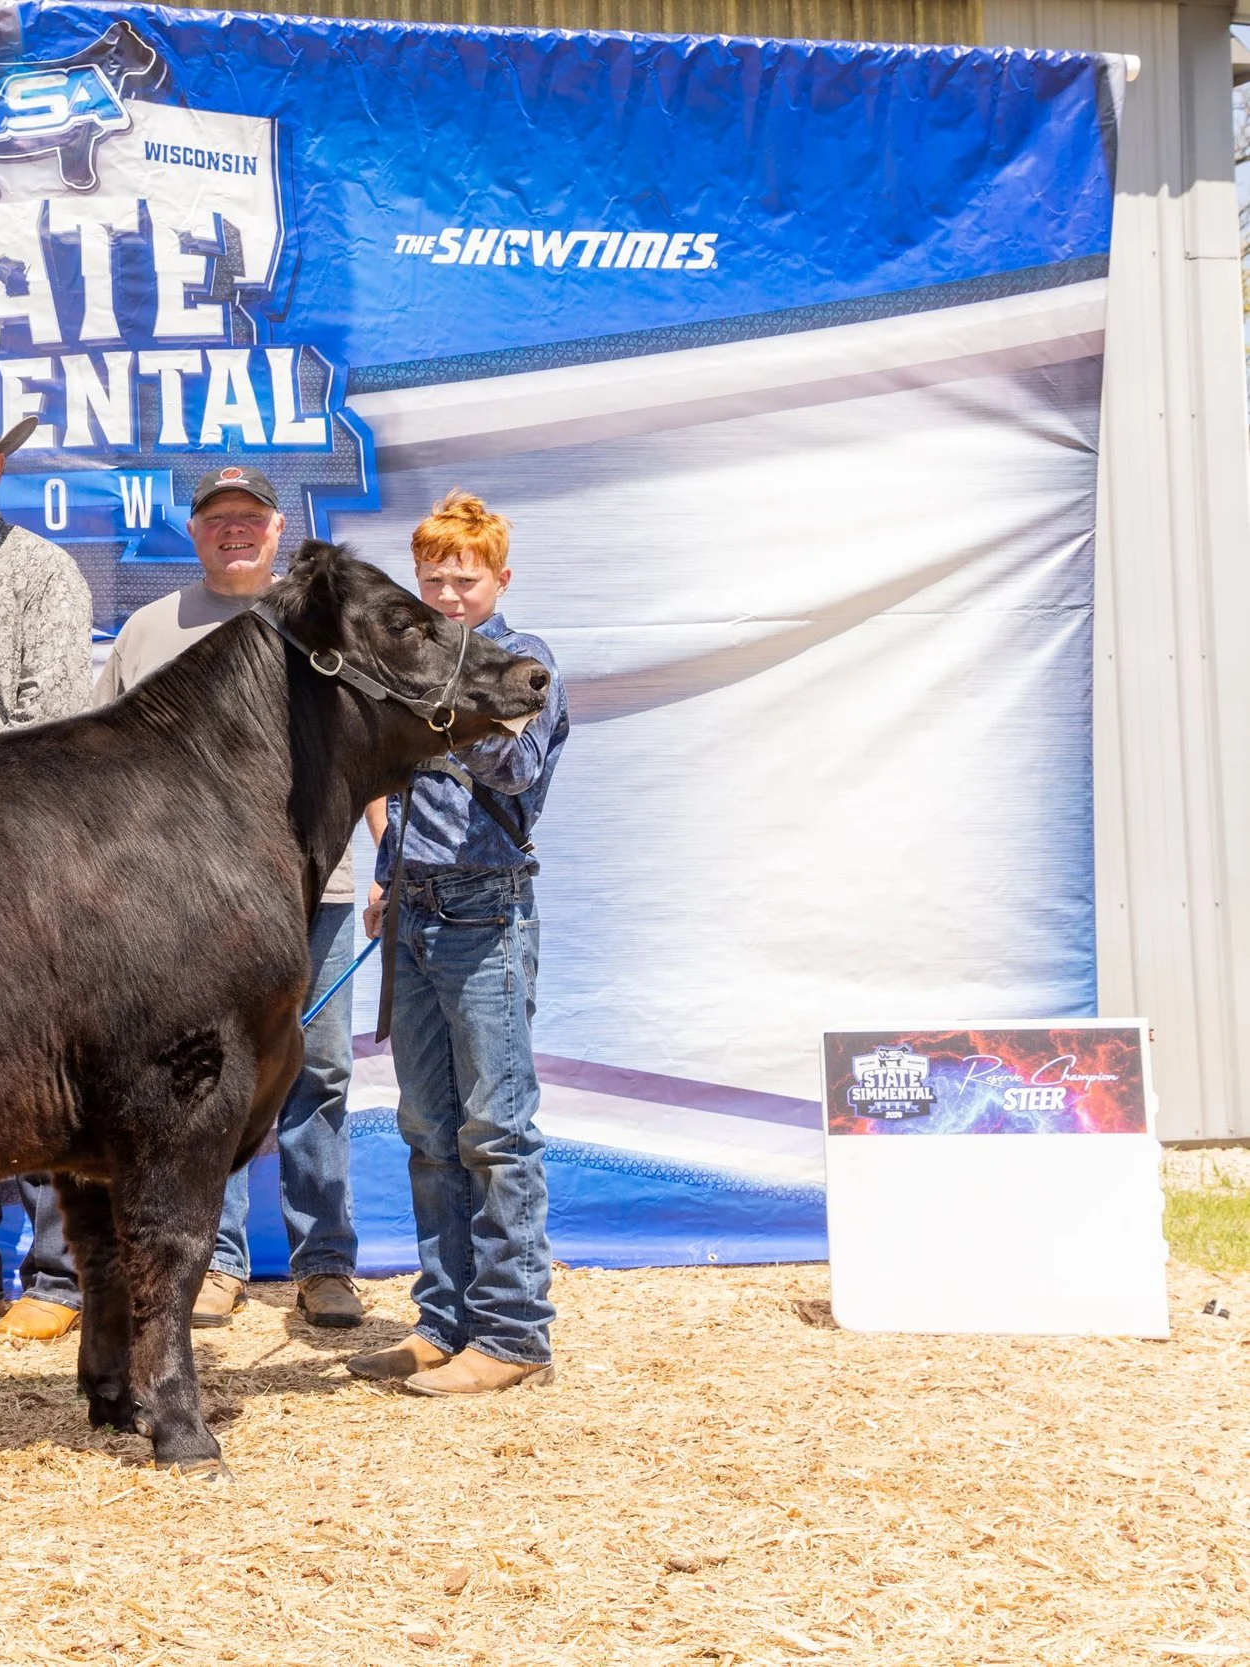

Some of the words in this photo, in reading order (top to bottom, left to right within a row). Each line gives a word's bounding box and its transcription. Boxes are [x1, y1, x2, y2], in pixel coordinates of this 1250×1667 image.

[144, 139, 259, 176] WISCONSIN
[394, 233, 438, 255] THE
[431, 226, 719, 270] SHOWTIMES
[863, 1068, 922, 1088] STATE
[959, 1054, 1024, 1096] Reserve
[1031, 1054, 1119, 1091] Champion
[852, 1087, 934, 1101] SIMMENTAL
[1003, 1086, 1067, 1112] STEER
